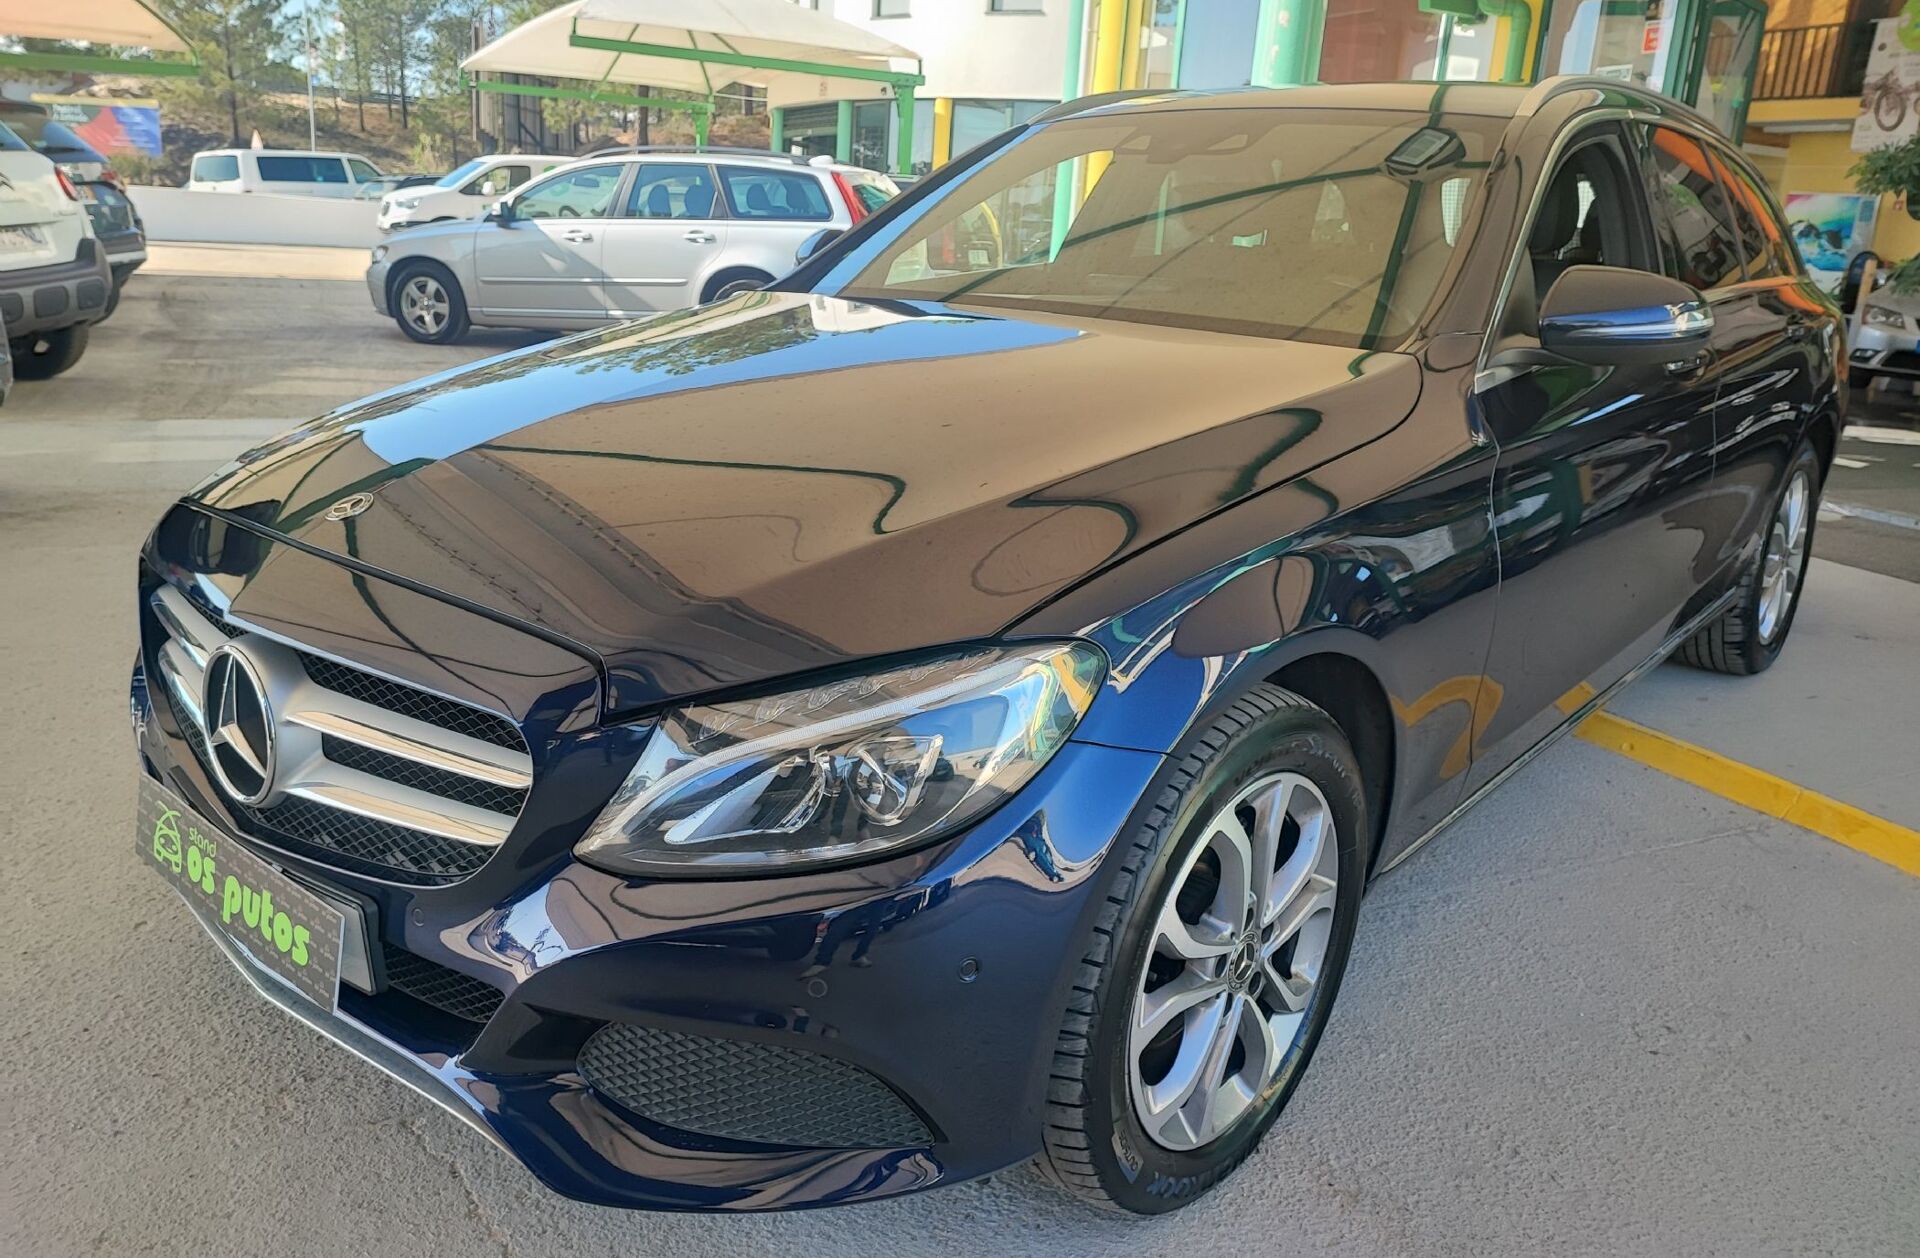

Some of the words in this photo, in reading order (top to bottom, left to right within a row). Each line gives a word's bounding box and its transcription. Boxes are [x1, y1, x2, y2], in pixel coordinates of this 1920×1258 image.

[188, 826, 217, 858] stand
[187, 845, 216, 895] os
[222, 874, 311, 967] putos
